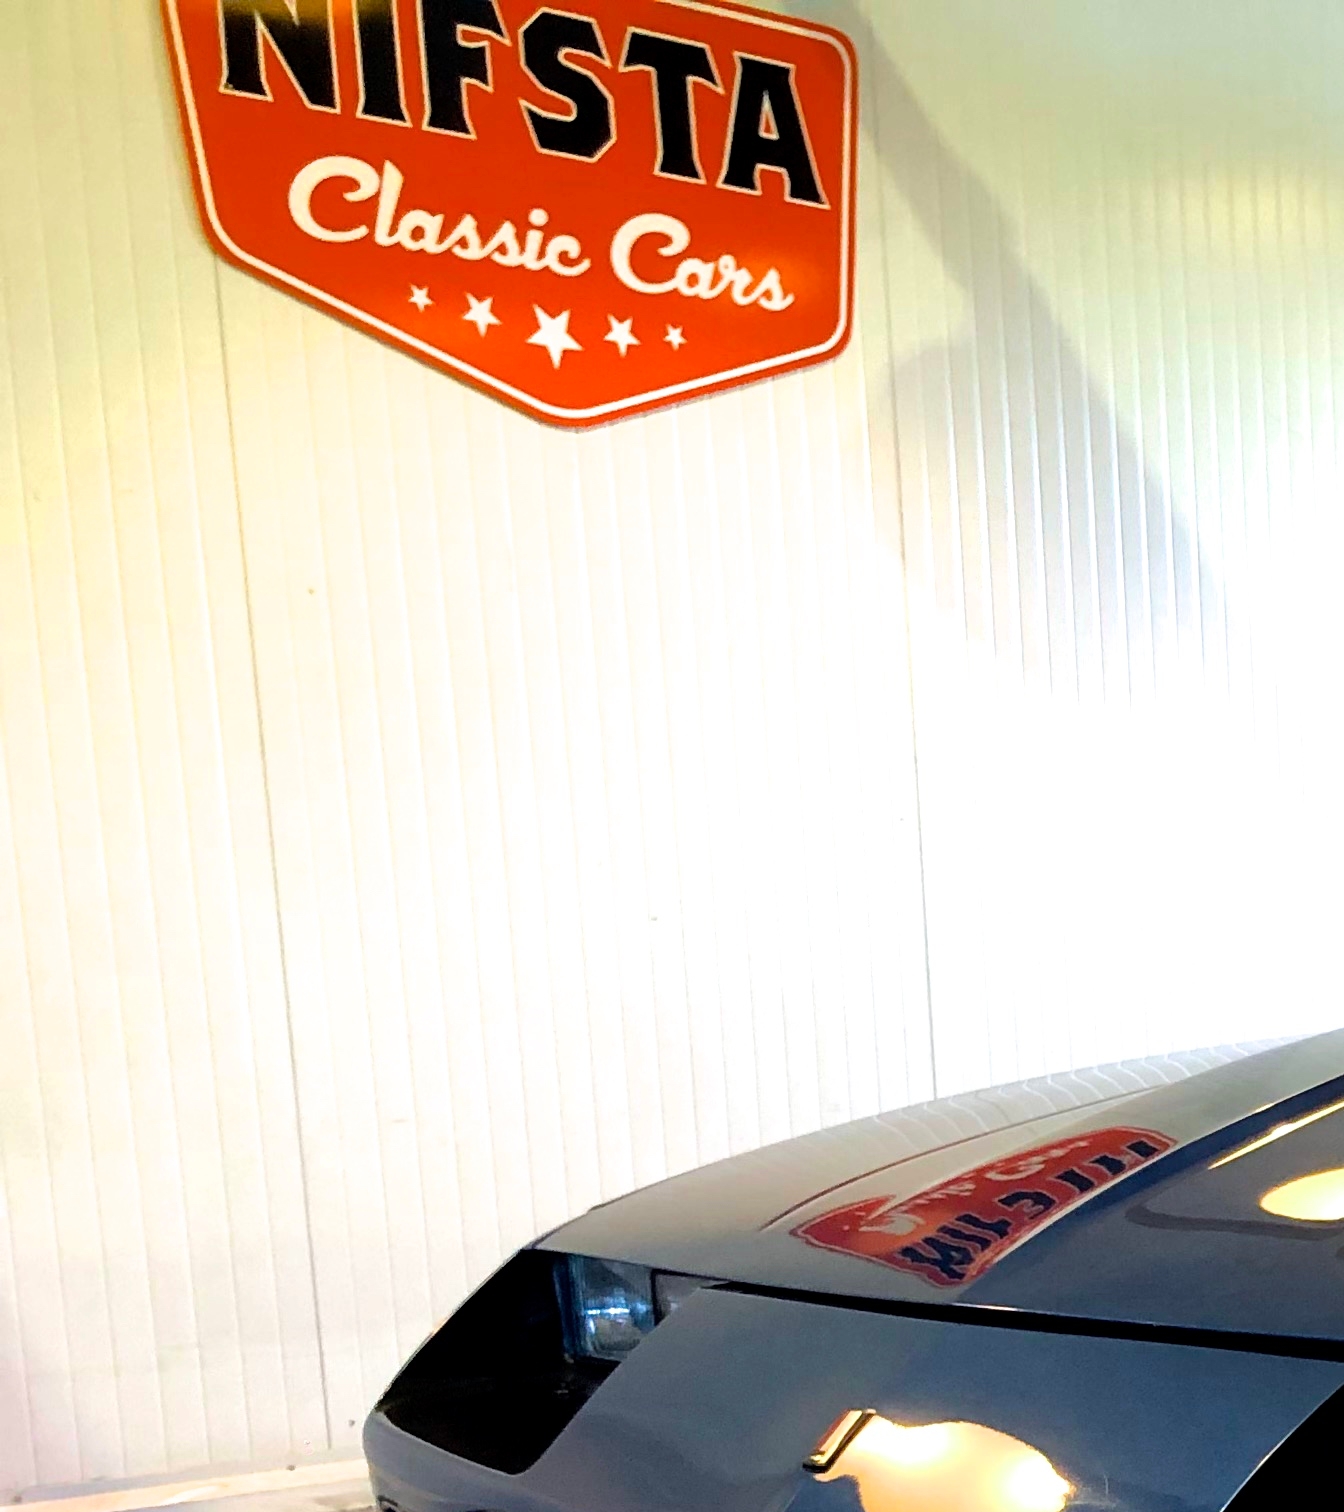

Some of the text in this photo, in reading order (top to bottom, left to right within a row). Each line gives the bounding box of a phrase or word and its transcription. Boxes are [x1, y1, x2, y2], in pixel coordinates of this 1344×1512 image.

[219, 0, 831, 209] NIFSTA
[287, 155, 795, 312] Classic Cars
